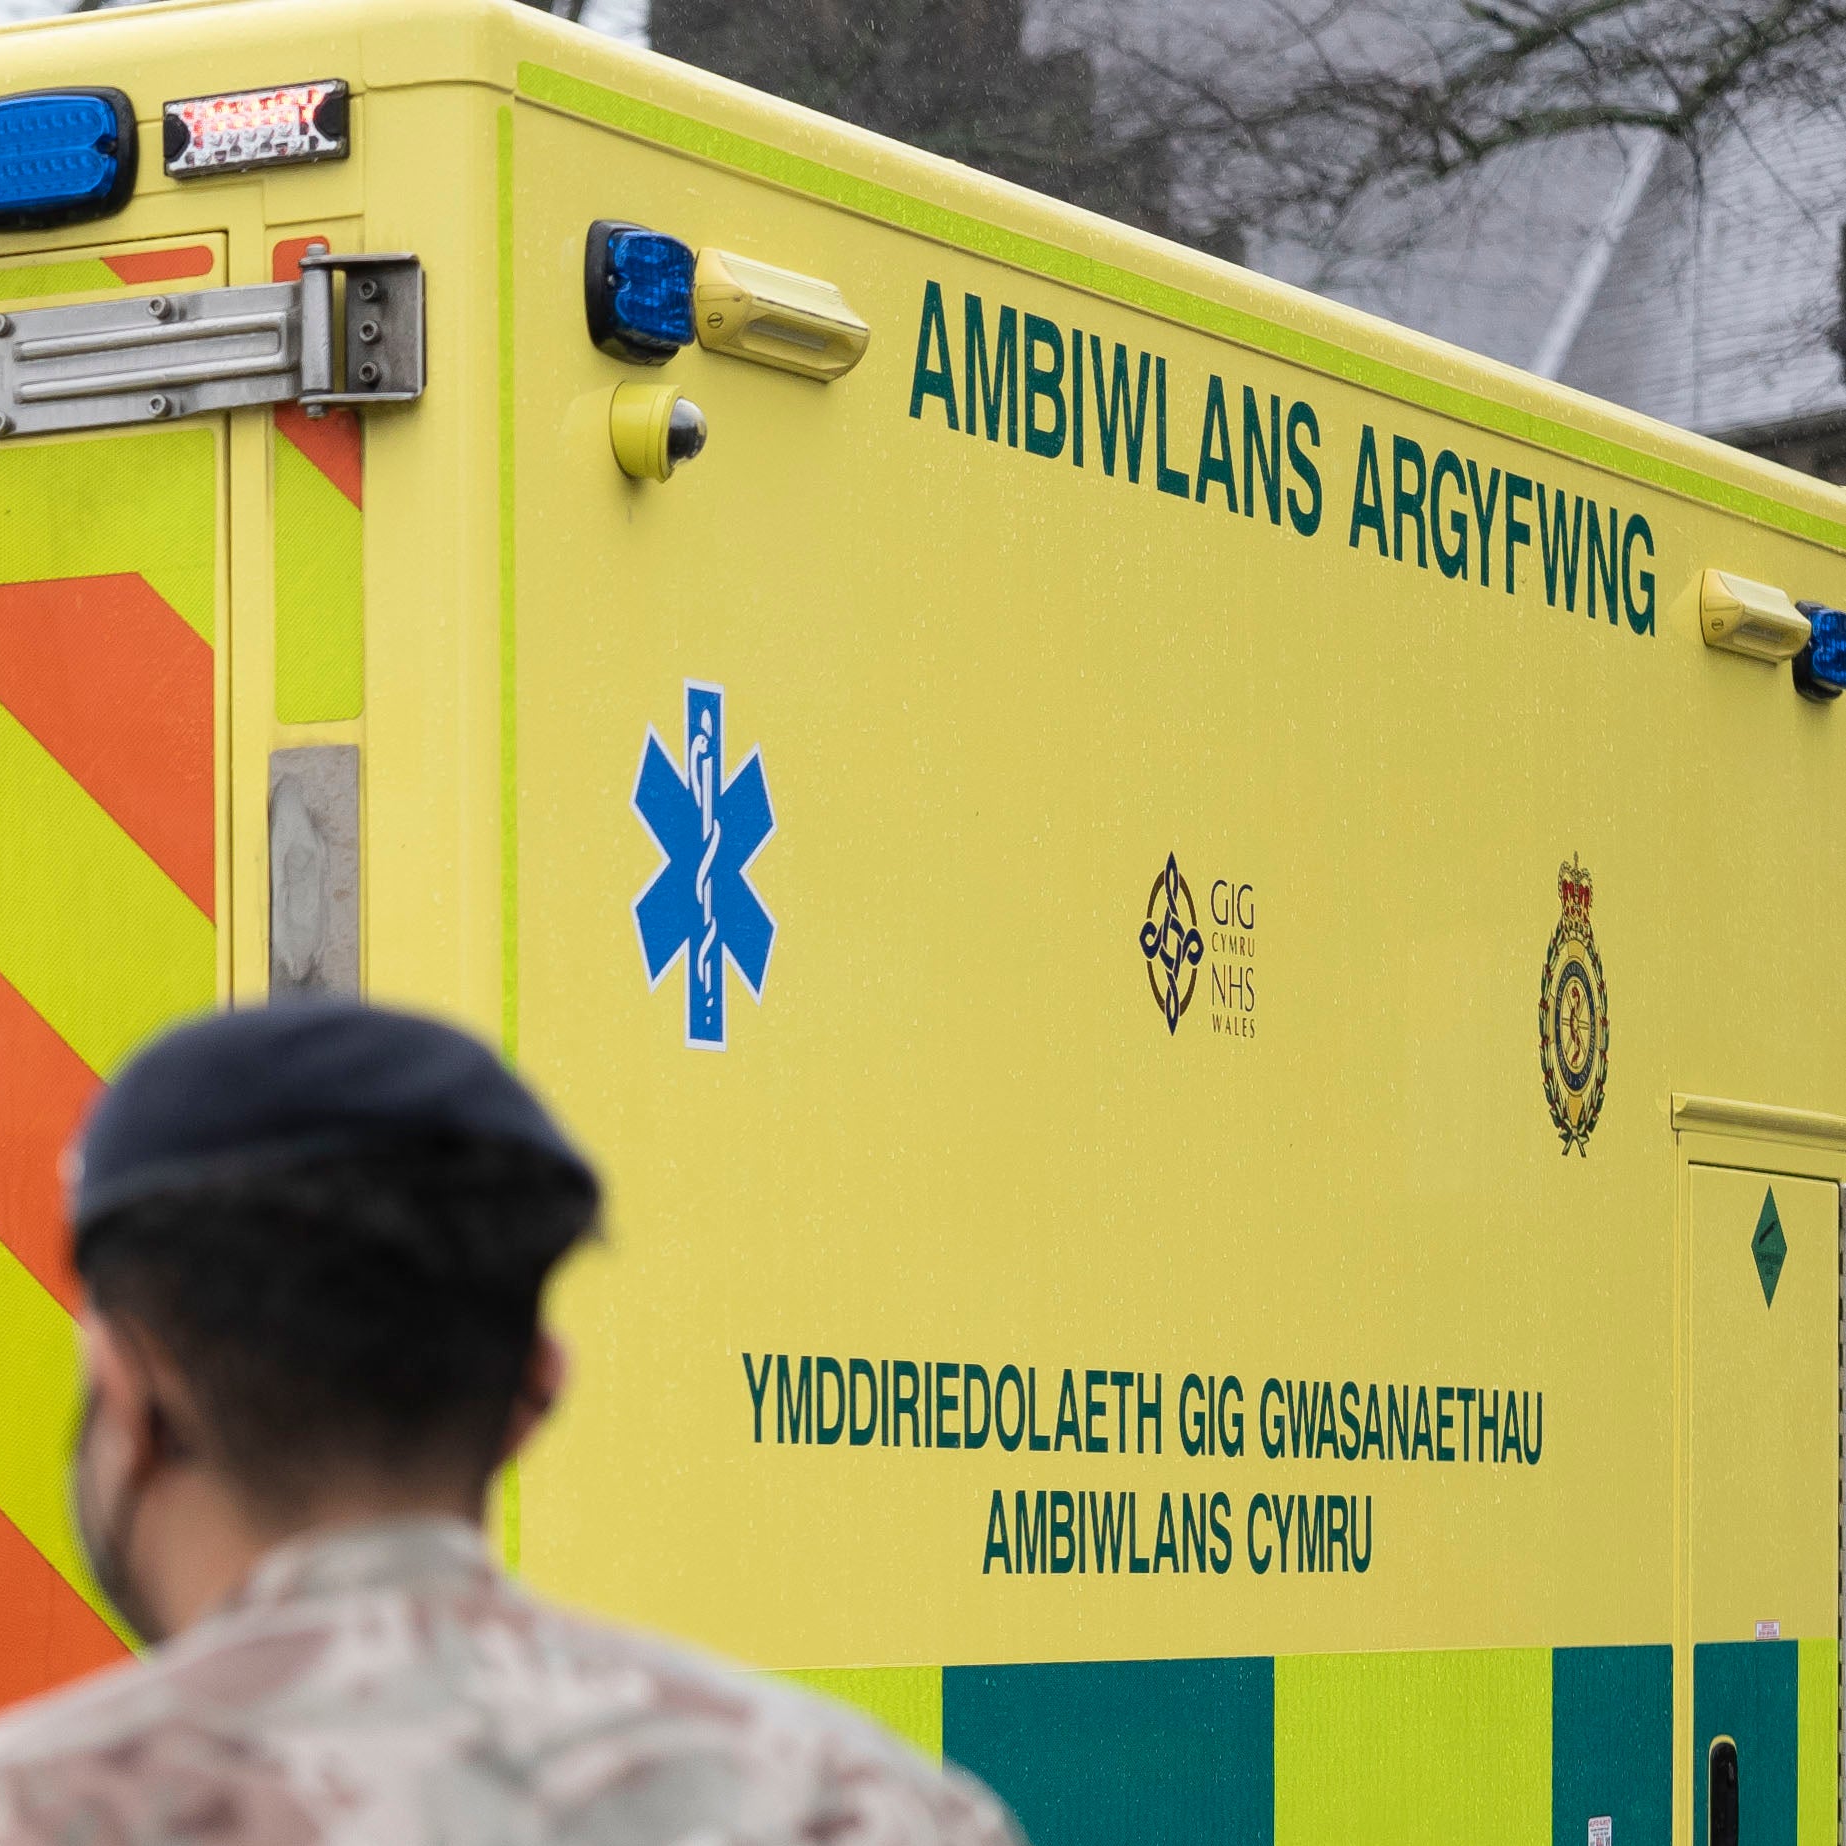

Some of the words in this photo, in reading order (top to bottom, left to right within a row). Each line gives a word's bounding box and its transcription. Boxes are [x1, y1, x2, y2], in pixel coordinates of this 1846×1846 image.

[909, 279, 1322, 538] AMBIWLANS
[1349, 423, 1656, 638] ARGYFWNG
[1210, 879, 1255, 930] GIG
[1211, 931, 1255, 958] CYMRU
[1211, 961, 1255, 1013] NHS
[1212, 1013, 1255, 1039] WALES
[741, 1352, 1162, 1455] YMDDIRIEDOLAETH
[1179, 1372, 1245, 1457] GIG
[1259, 1377, 1543, 1466] GWASANAETHAU
[982, 1489, 1233, 1575] AMBIWLANS
[1247, 1492, 1372, 1575] CYMRU
